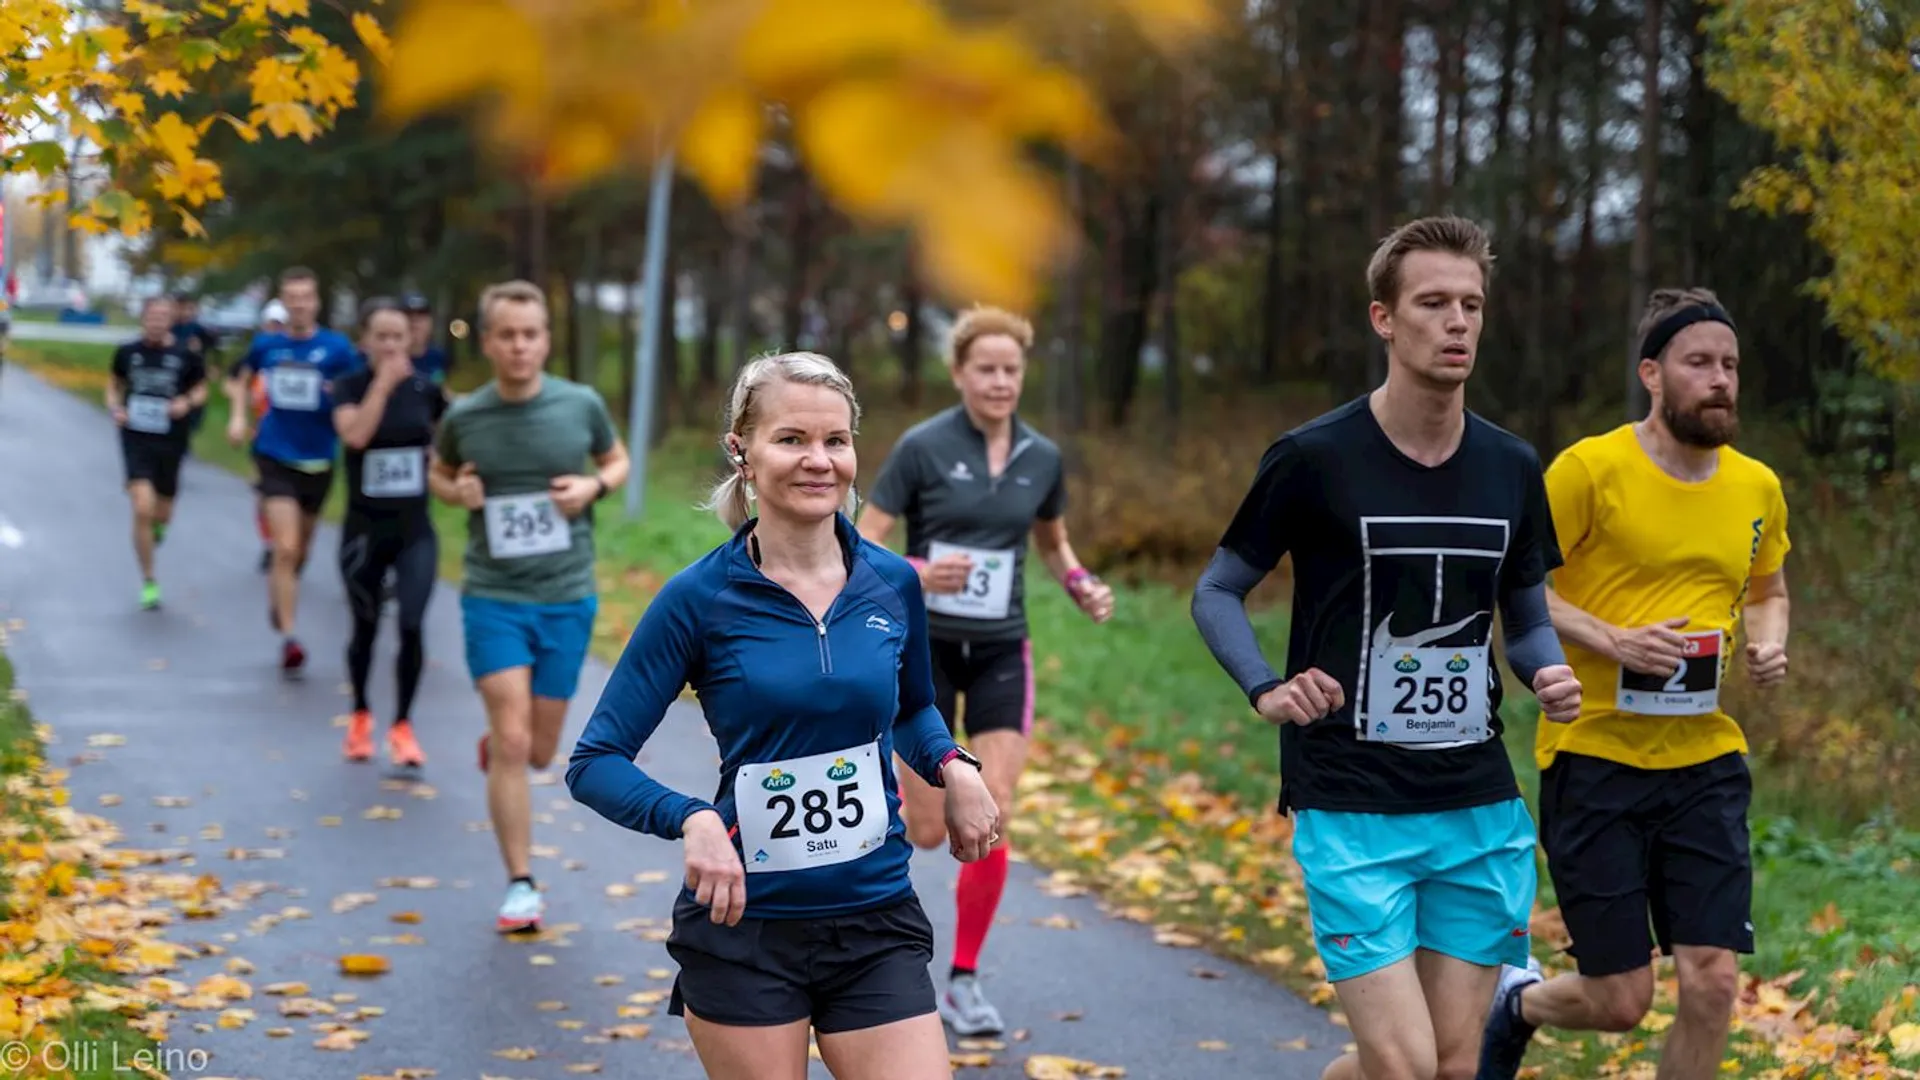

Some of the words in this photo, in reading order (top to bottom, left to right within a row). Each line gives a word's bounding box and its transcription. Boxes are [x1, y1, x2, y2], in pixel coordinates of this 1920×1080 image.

[501, 508, 555, 539] 295
[1392, 675, 1468, 715] 258
[1406, 719, 1456, 732] Benjamin
[831, 764, 854, 778] Arla
[766, 776, 791, 788] Arla
[766, 781, 864, 840] 285
[806, 838, 838, 852] Satu
